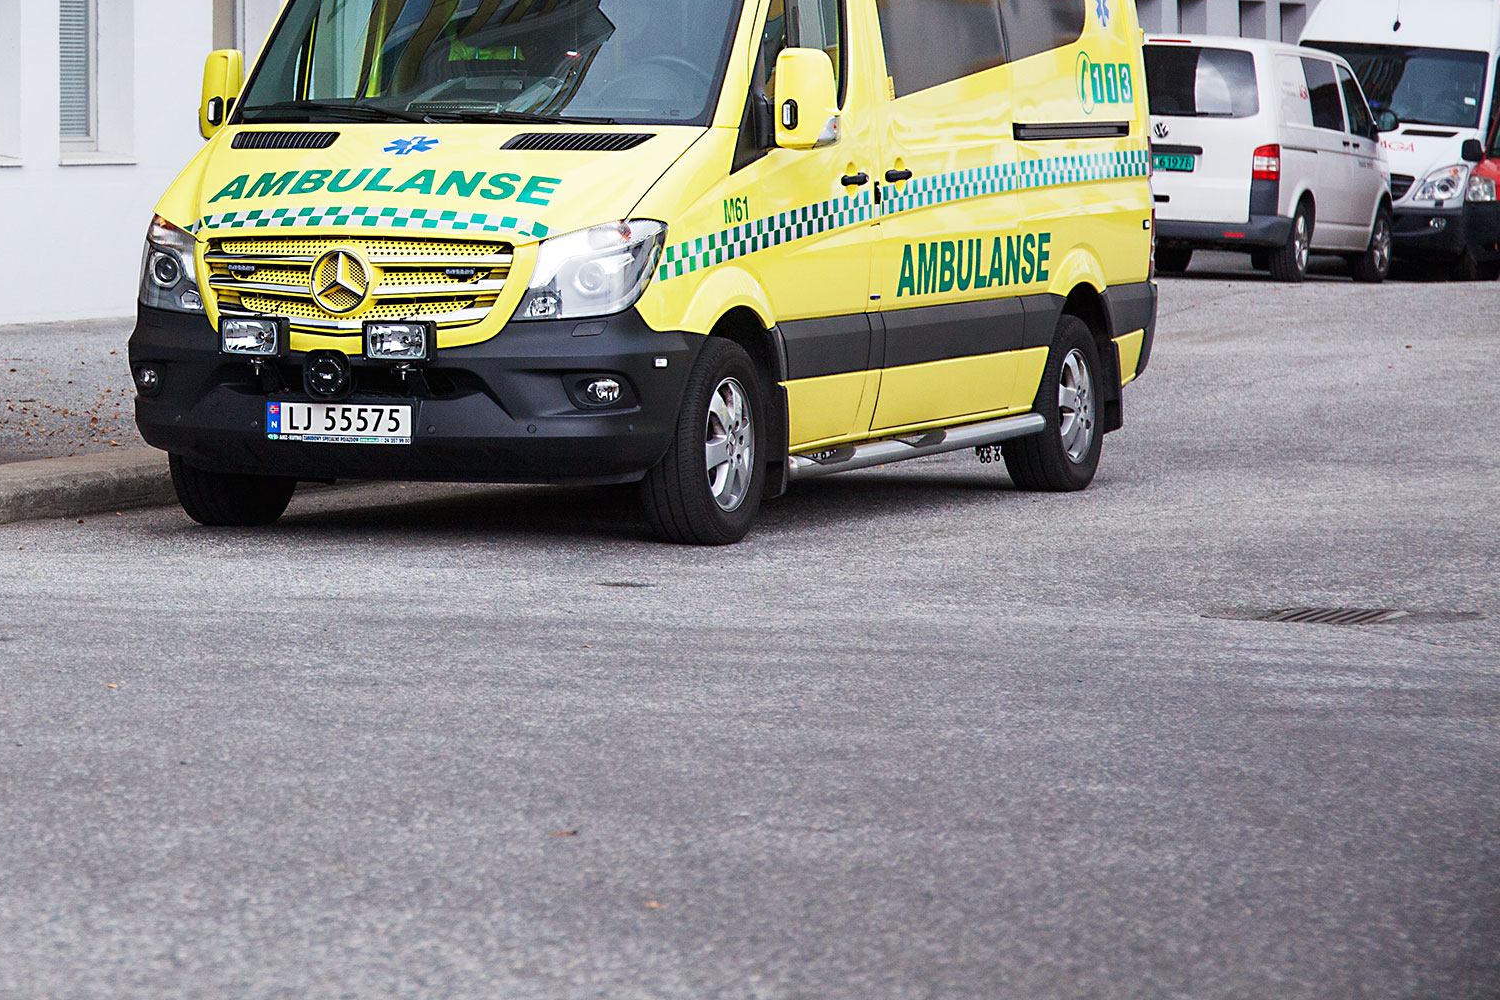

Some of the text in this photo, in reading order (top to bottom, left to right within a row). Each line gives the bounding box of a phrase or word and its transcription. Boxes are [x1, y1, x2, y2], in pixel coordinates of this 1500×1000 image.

[1093, 66, 1131, 101] 113
[207, 167, 563, 207] AMBULANSE
[723, 196, 749, 224] M61
[896, 232, 1051, 298] AMBULANSE
[271, 420, 278, 429] N
[289, 406, 401, 433] LJ 55575
